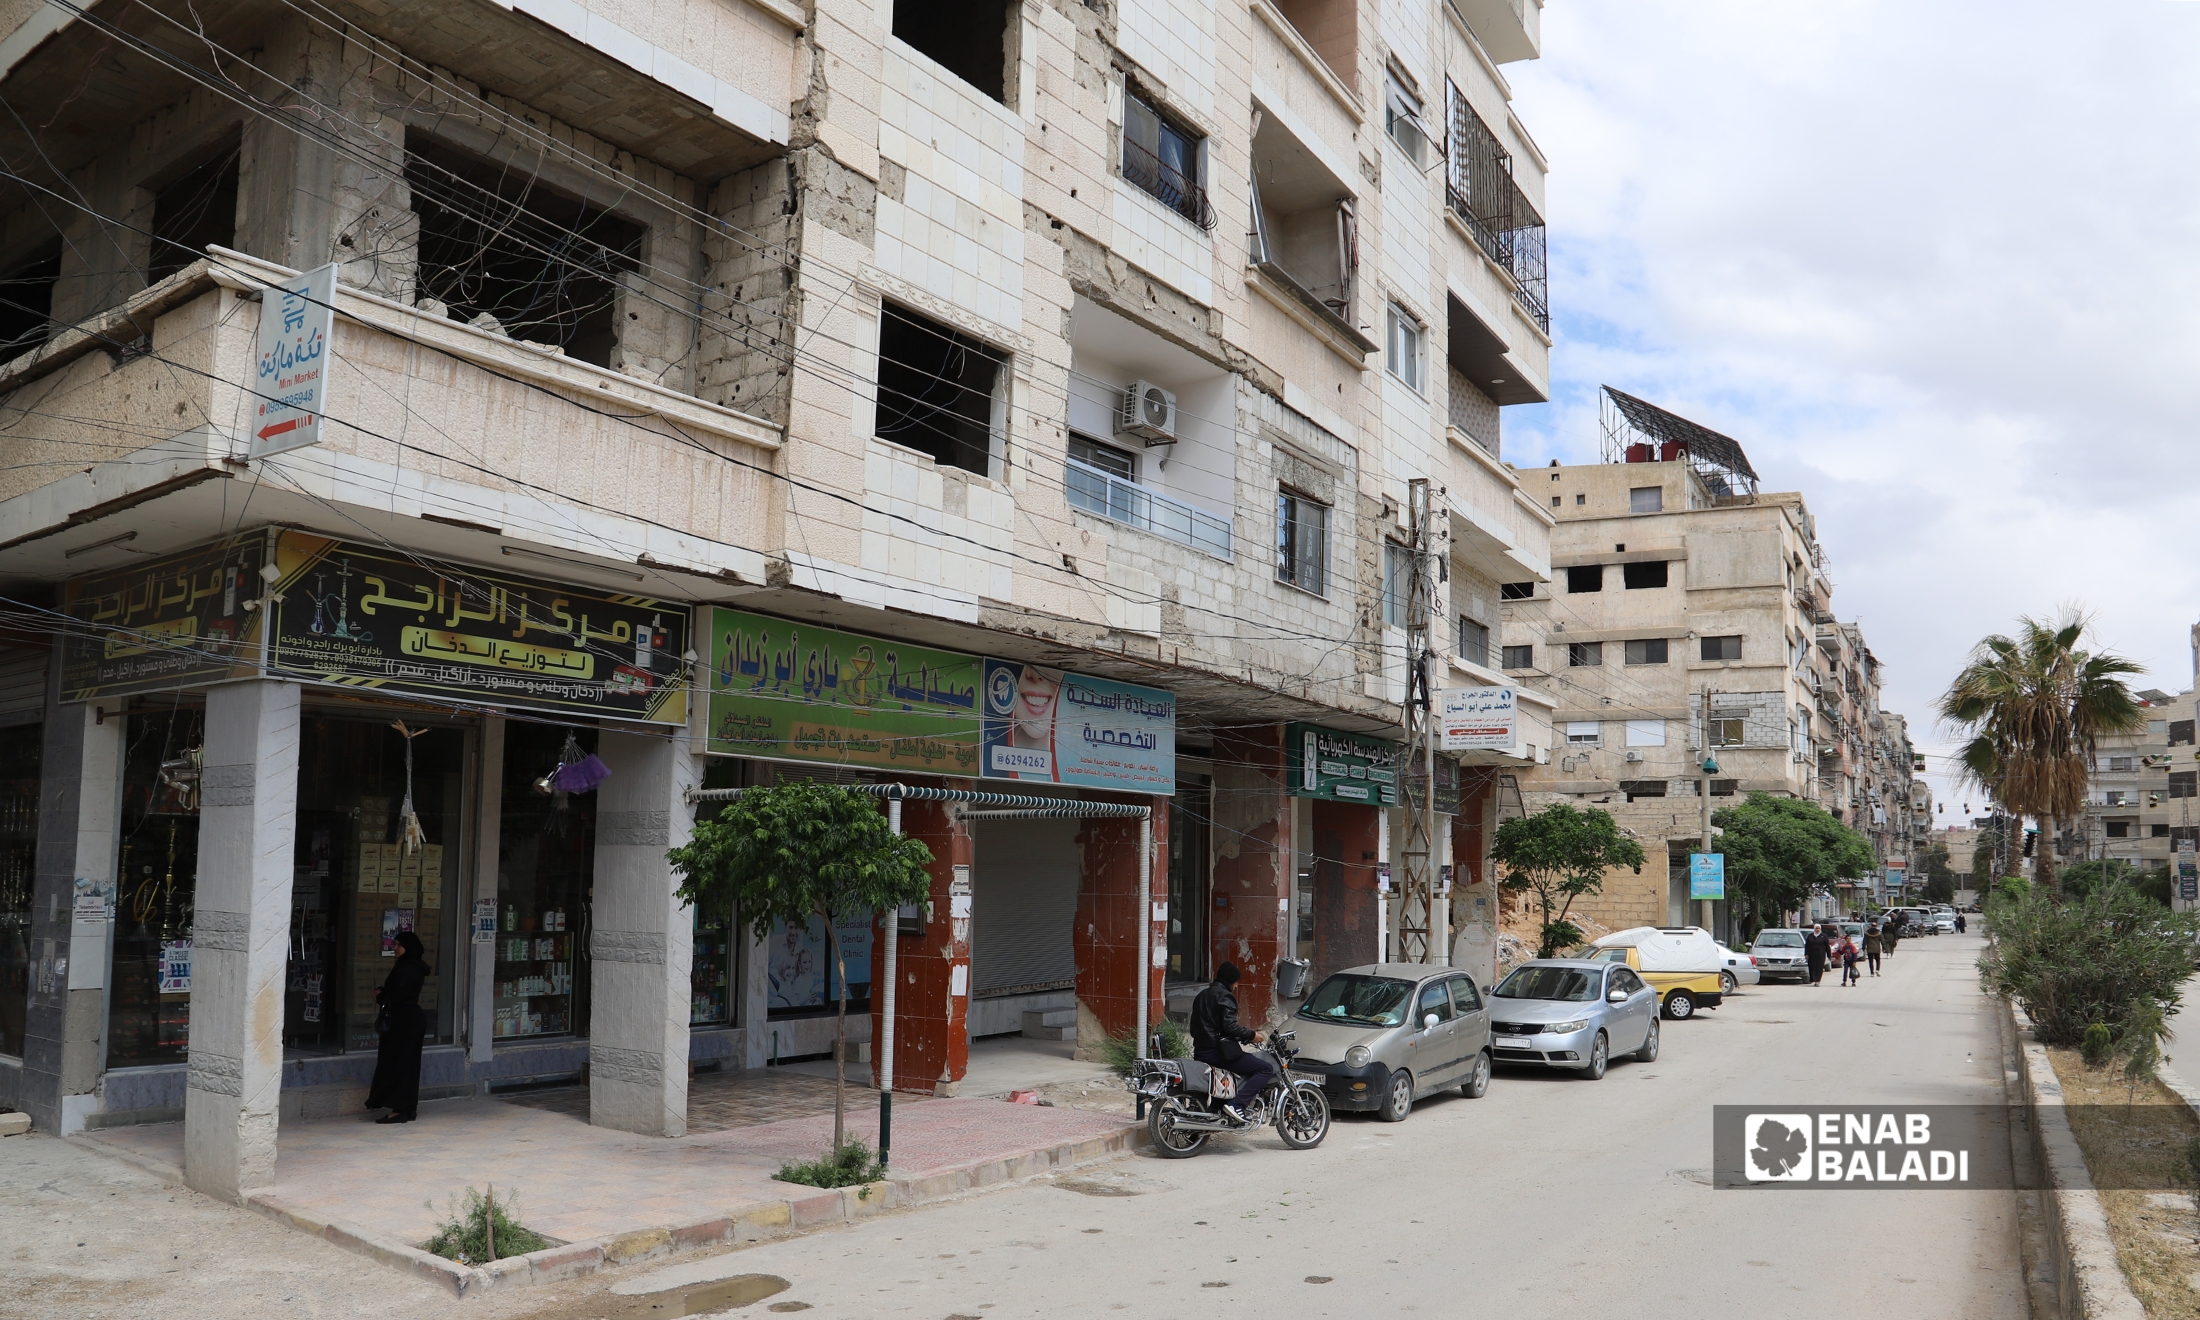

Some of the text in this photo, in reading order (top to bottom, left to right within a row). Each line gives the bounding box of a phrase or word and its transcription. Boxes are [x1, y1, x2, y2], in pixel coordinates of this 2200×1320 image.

[260, 340, 292, 381] ماركت
[279, 368, 318, 390] Mini Market
[154, 566, 223, 619] مركز
[361, 576, 631, 648] مركز الراجح
[314, 640, 331, 651] راجح
[412, 631, 586, 671] لتوزيع الدخان
[480, 673, 529, 690] مستورد
[721, 628, 975, 717] صيدلية باري أبو زيدان
[536, 679, 569, 698] وطني
[1479, 690, 1496, 699] الدكتور
[1066, 683, 1171, 720] العيادة السنية
[1446, 702, 1466, 713] السباع
[1468, 700, 1478, 713] أبو
[1479, 702, 1492, 713] علي
[795, 727, 826, 751] تجميل
[1083, 722, 1156, 751] التخصصية
[1318, 733, 1353, 758] الكهربائية
[890, 737, 919, 759] أطفال
[955, 742, 977, 767] أدوية
[1353, 741, 1380, 764] الهندسة
[1005, 754, 1045, 768] 6294262
[1322, 762, 1347, 776] ELECTRICAL
[1351, 766, 1366, 777] POWER
[835, 920, 871, 930] Specialist
[842, 935, 865, 943] Dental
[843, 950, 864, 958] Clinic
